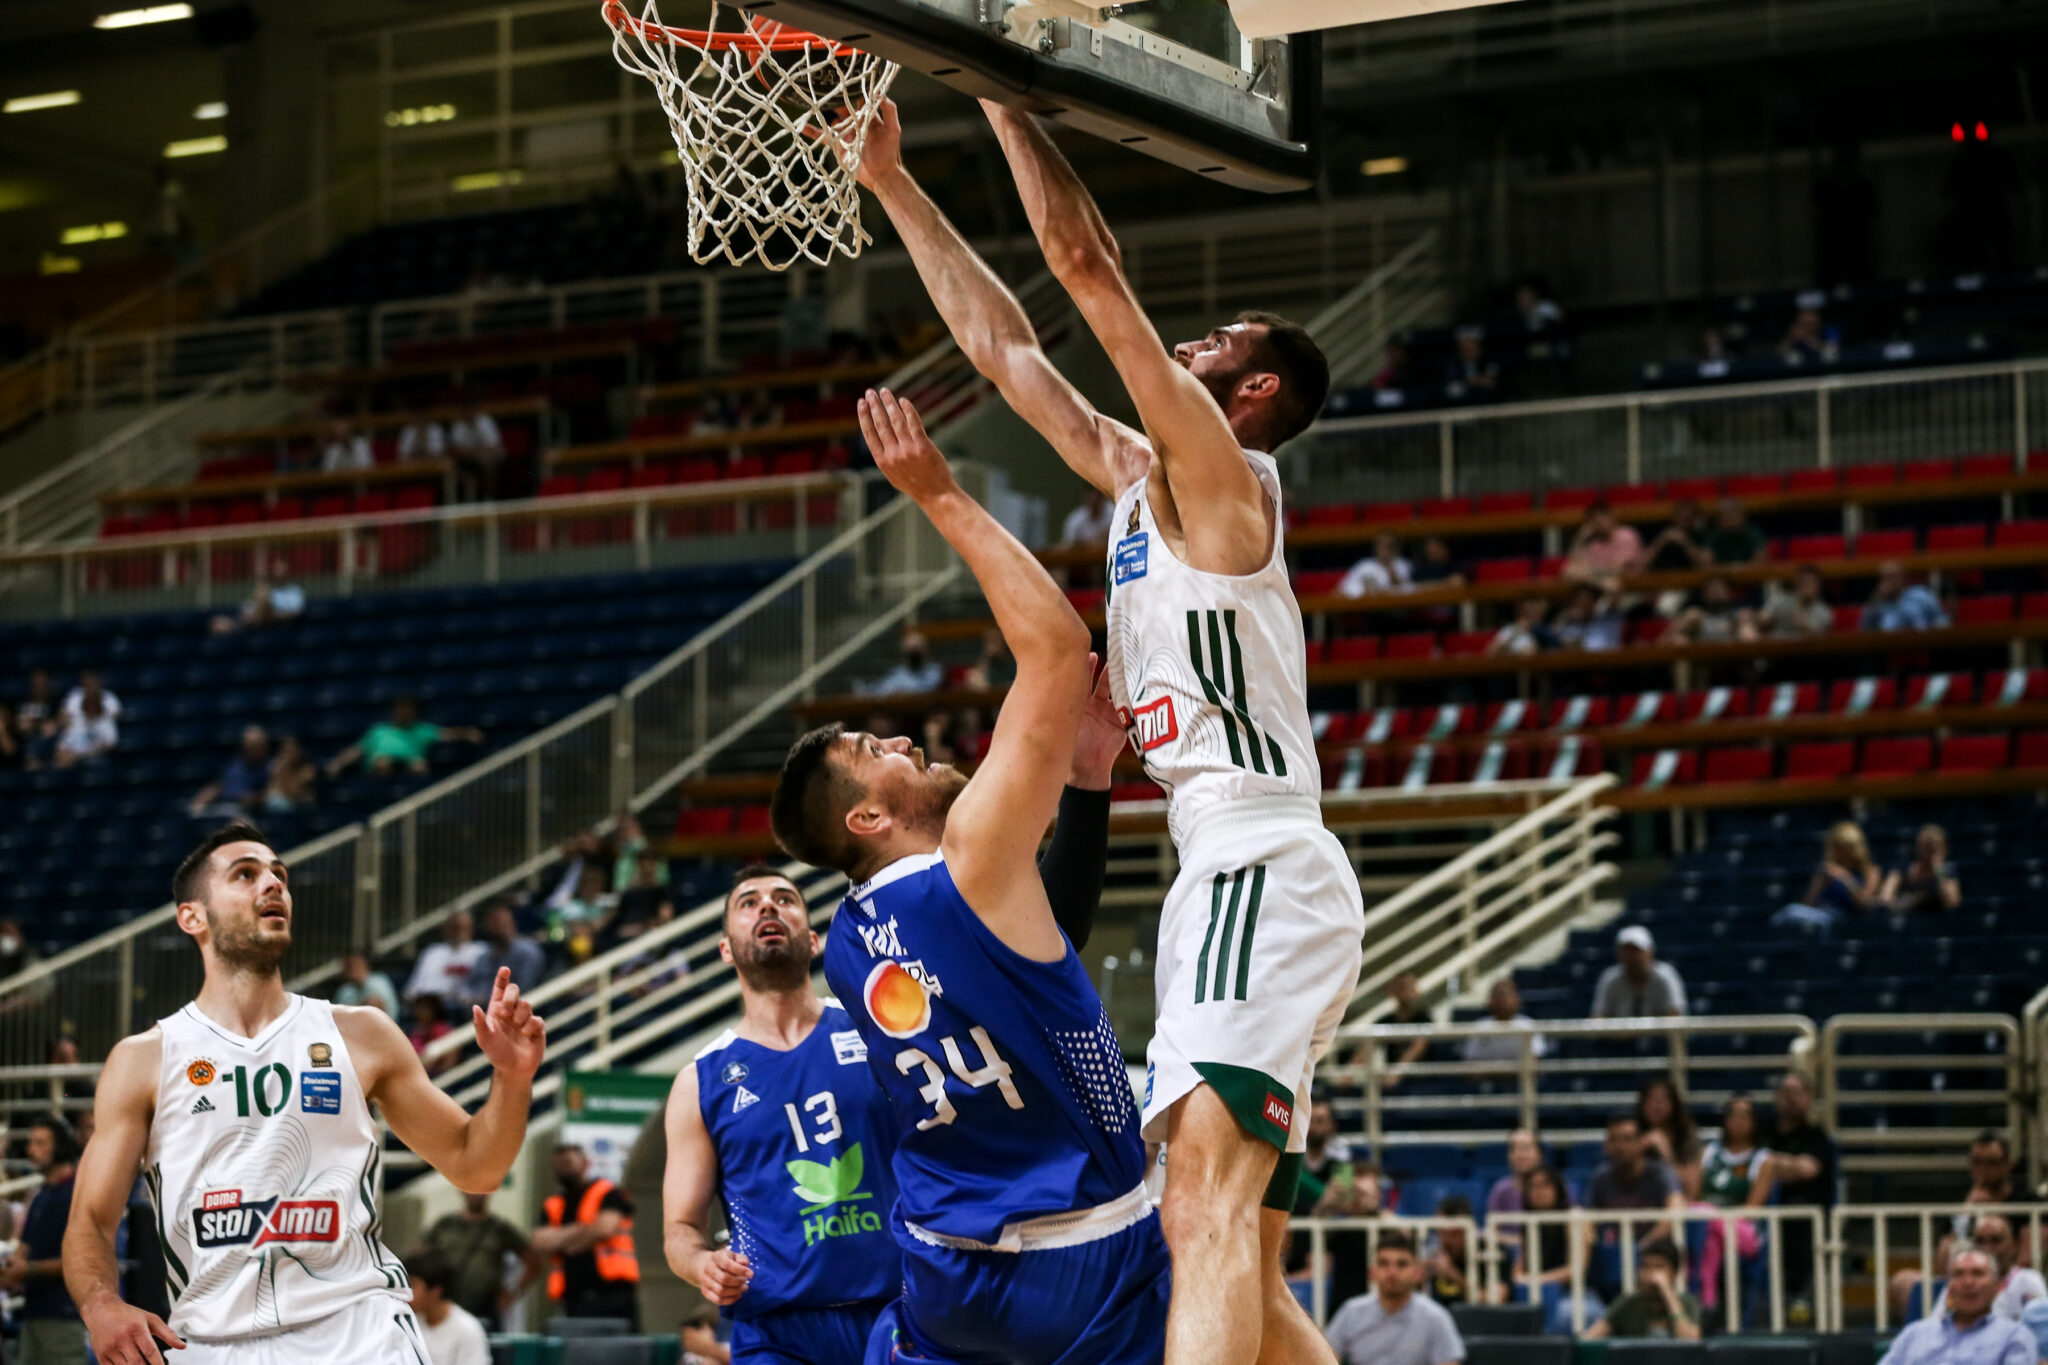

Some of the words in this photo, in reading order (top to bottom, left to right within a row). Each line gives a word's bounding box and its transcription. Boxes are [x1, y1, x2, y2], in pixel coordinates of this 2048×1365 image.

[222, 1062, 293, 1117] 10
[895, 1025, 1026, 1132] 34
[784, 1090, 843, 1153] 13
[1266, 1100, 1290, 1127] AVIS
[205, 1190, 239, 1209] pame
[803, 1205, 882, 1247] Haifa
